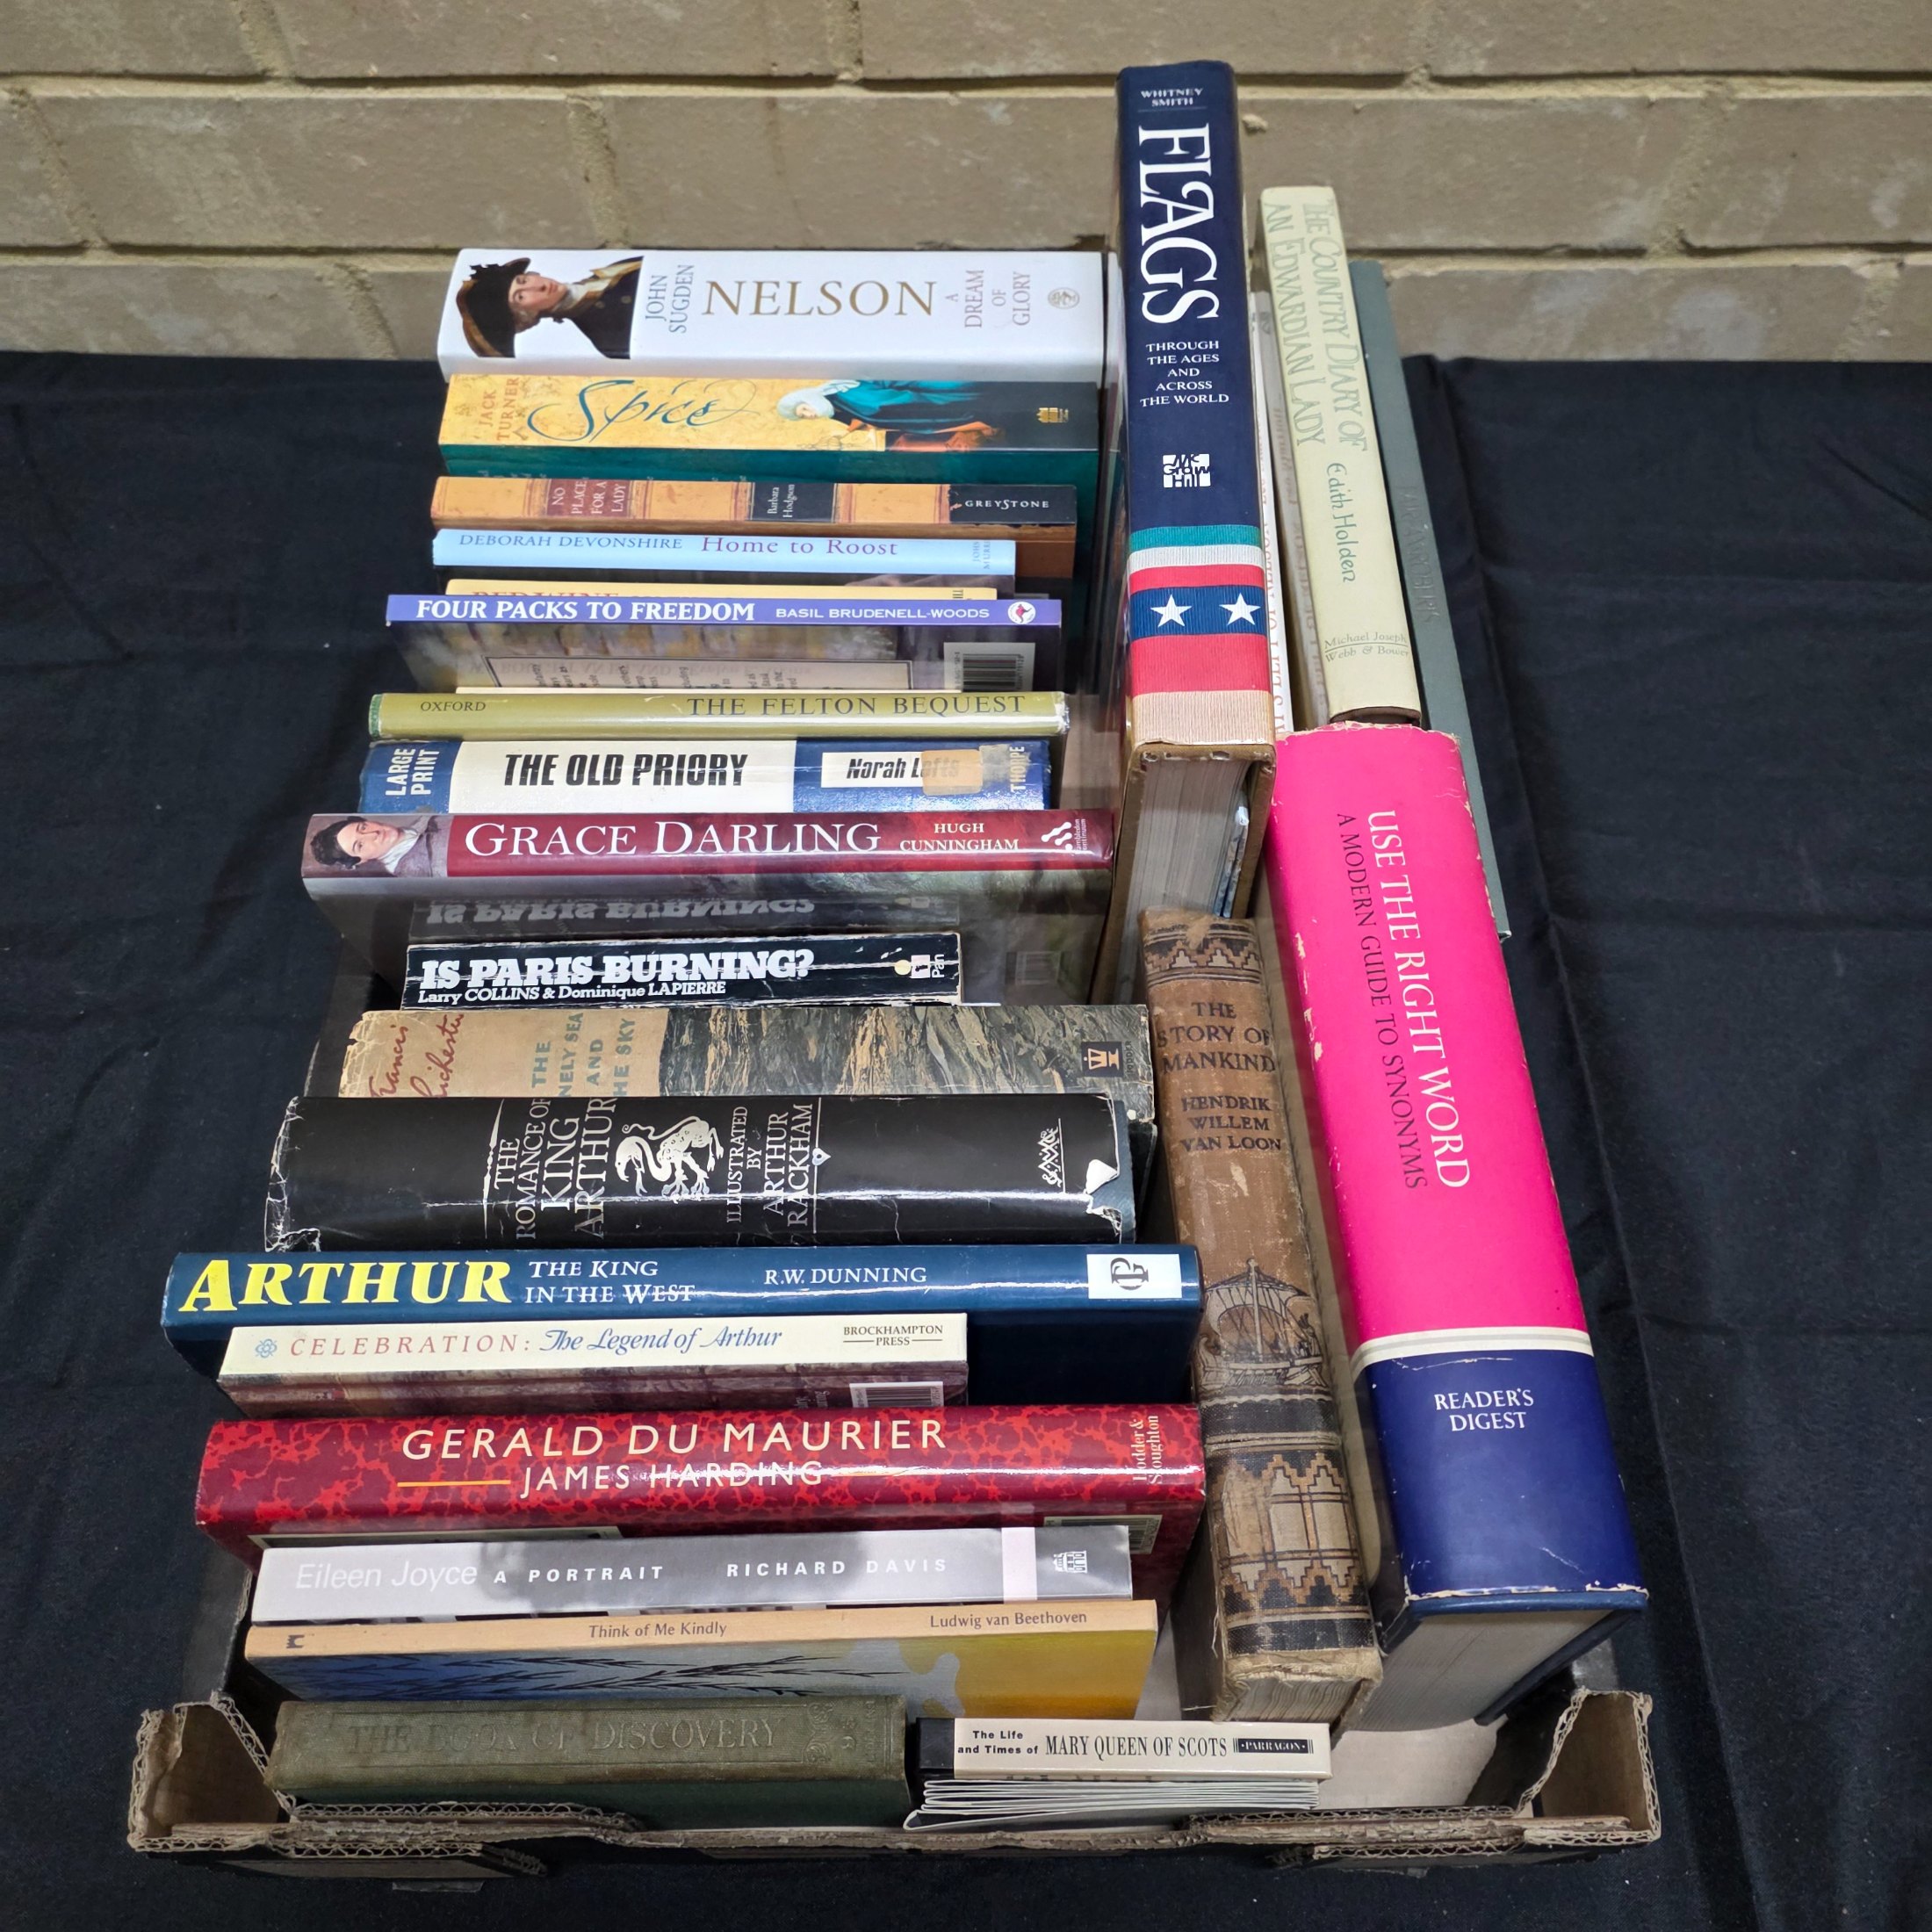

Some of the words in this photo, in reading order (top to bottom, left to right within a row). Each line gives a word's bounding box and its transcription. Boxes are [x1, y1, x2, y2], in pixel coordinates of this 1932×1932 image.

[1141, 88, 1203, 99] WHITNEY
[1151, 97, 1193, 107] SMITH
[1138, 122, 1220, 324] FLAGS
[1265, 203, 1294, 234] AN
[1303, 198, 1336, 234] THE
[645, 274, 668, 321] JOHN
[669, 264, 695, 334] SUGDEN
[701, 279, 938, 317] NELSON
[945, 292, 959, 303] A
[964, 269, 984, 328] DREAM
[991, 288, 1006, 307] OF
[1012, 270, 1032, 327] GLORY
[1308, 236, 1350, 340] COUNTRY
[1270, 237, 1316, 376] EDWARDIAN
[1146, 341, 1219, 352] THROUGH
[1147, 355, 1177, 365] THE
[1181, 354, 1220, 364] AGES
[1156, 381, 1213, 392] ACROSS
[1167, 368, 1200, 378] AND
[1325, 343, 1363, 418] DIARY
[479, 389, 497, 428] JACK
[497, 377, 520, 441] TURNER
[527, 379, 761, 443] Spice
[1140, 395, 1170, 407] THE
[1174, 393, 1229, 404] WORLD
[1290, 377, 1326, 446] LADY
[1337, 419, 1368, 452] OF
[611, 483, 627, 513] LADY
[1327, 462, 1353, 509] Edith
[591, 490, 603, 515] FOR
[768, 487, 780, 515] Barbara
[783, 484, 797, 518] Hodgson
[965, 499, 1050, 510] GREYSTONE
[459, 534, 551, 546] DEBORAH
[559, 536, 682, 549] DEVONSHIRE
[701, 536, 779, 553] Home
[790, 540, 814, 554] to
[826, 538, 898, 555] Roost
[1333, 514, 1359, 583] Holden
[416, 600, 487, 619] FOUR
[495, 600, 579, 620] PACKS
[587, 602, 622, 620] TO
[630, 602, 755, 622] FREEDOM
[775, 608, 824, 619] BASIL
[1324, 631, 1369, 650] Michael
[1373, 631, 1407, 644] Joseph
[1325, 646, 1358, 663] Webb
[421, 701, 487, 711] OXFORD
[687, 697, 746, 716] THE
[762, 697, 877, 716] FELTON
[892, 695, 1026, 717] BEQUEST
[386, 748, 415, 796] LARGE
[411, 749, 440, 796] PRINT
[504, 753, 559, 786] THE
[566, 753, 623, 786] OLD
[631, 753, 748, 786] PRIORY
[847, 758, 911, 779] Norah
[1009, 746, 1026, 793] THORPE
[934, 823, 984, 834] HUGH
[1337, 813, 1357, 826] A
[465, 822, 637, 856] GRACE
[651, 820, 882, 856] DARLING
[899, 839, 1019, 851] CUNNINGHAM
[1367, 811, 1406, 868] USE
[1340, 833, 1377, 926] MODERN
[1380, 875, 1421, 941] THE
[420, 960, 460, 990] IS
[467, 955, 595, 988] PARIS
[602, 948, 815, 984] BURNING?
[932, 954, 945, 978] Pan
[1360, 935, 1392, 1006] GUIDE
[417, 990, 462, 1006] Larry
[464, 986, 539, 1002] COLLINS
[542, 987, 555, 999] &
[559, 984, 645, 1000] Dominique
[648, 981, 726, 997] LAPIERRE
[1395, 951, 1446, 1059] RIGHT
[1192, 1002, 1236, 1019] THE
[568, 1013, 584, 1043] SEA
[616, 1018, 636, 1055] SKY
[1157, 1025, 1235, 1048] STORY
[1244, 1027, 1272, 1046] OF
[1375, 1013, 1399, 1045] TO
[531, 1041, 551, 1088] THE
[586, 1039, 603, 1085] AND
[1162, 1051, 1275, 1074] MANKIND
[1181, 1096, 1272, 1112] HENDRIK
[1187, 1115, 1270, 1131] WILLEM
[1382, 1055, 1428, 1189] SYNONYMS
[1418, 1066, 1470, 1188] WORD
[746, 1146, 762, 1170] BY
[1179, 1136, 1222, 1152] VAN
[1228, 1135, 1281, 1150] LOON
[494, 1137, 521, 1190] THE
[540, 1117, 580, 1212] KING
[574, 1097, 617, 1240] ARTHUR
[726, 1106, 748, 1223] ILLUSTRATED
[763, 1112, 789, 1215] ARTHUR
[788, 1103, 813, 1228] RACKHAM
[515, 1121, 545, 1240] ROMANCE
[529, 1261, 581, 1278] THE
[588, 1260, 659, 1278] KING
[764, 1269, 806, 1286] R.W.
[811, 1267, 927, 1284] DUNNING
[178, 1258, 513, 1312] ARTHUR
[525, 1287, 555, 1304] IN
[563, 1286, 614, 1303] THE
[623, 1284, 696, 1304] WEST
[539, 1329, 584, 1352] The
[587, 1327, 669, 1355] Legend
[674, 1327, 703, 1354] of
[699, 1326, 782, 1348] Arthur
[843, 1324, 943, 1337] BROCKHAMPTON
[876, 1337, 911, 1346] PRESS
[1434, 1388, 1534, 1410] READER'S
[1449, 1411, 1526, 1431] DIGEST
[401, 1425, 603, 1460] GERALD
[628, 1424, 698, 1455] DU
[724, 1418, 947, 1453] MAURIER
[520, 1465, 631, 1498] JAMES
[650, 1460, 822, 1489] HARDING
[296, 1563, 381, 1590] Eileen
[391, 1561, 478, 1593] Joyce
[494, 1570, 507, 1583] A
[528, 1566, 664, 1583] PORTRAIT
[726, 1560, 846, 1578] RICHARD
[866, 1559, 946, 1575] DAVIS
[589, 1624, 630, 1639] Think
[635, 1624, 651, 1637] of
[654, 1623, 675, 1636] Me
[680, 1621, 727, 1638] Kindly
[930, 1614, 982, 1629] Ludwig
[986, 1616, 1009, 1626] van
[1014, 1611, 1087, 1625] Beethoven
[349, 1725, 412, 1754] THE
[429, 1723, 525, 1752] BOOK
[591, 1717, 785, 1750] DISCOVERY
[957, 1745, 979, 1754] and
[984, 1745, 1021, 1754] Times
[1027, 1745, 1039, 1754] of
[973, 1730, 994, 1739] The
[1000, 1730, 1023, 1739] Life
[1045, 1735, 1090, 1755] MARY
[1094, 1735, 1149, 1761] QUEEN
[1153, 1736, 1173, 1757] OF
[1179, 1736, 1227, 1757] SCOTS
